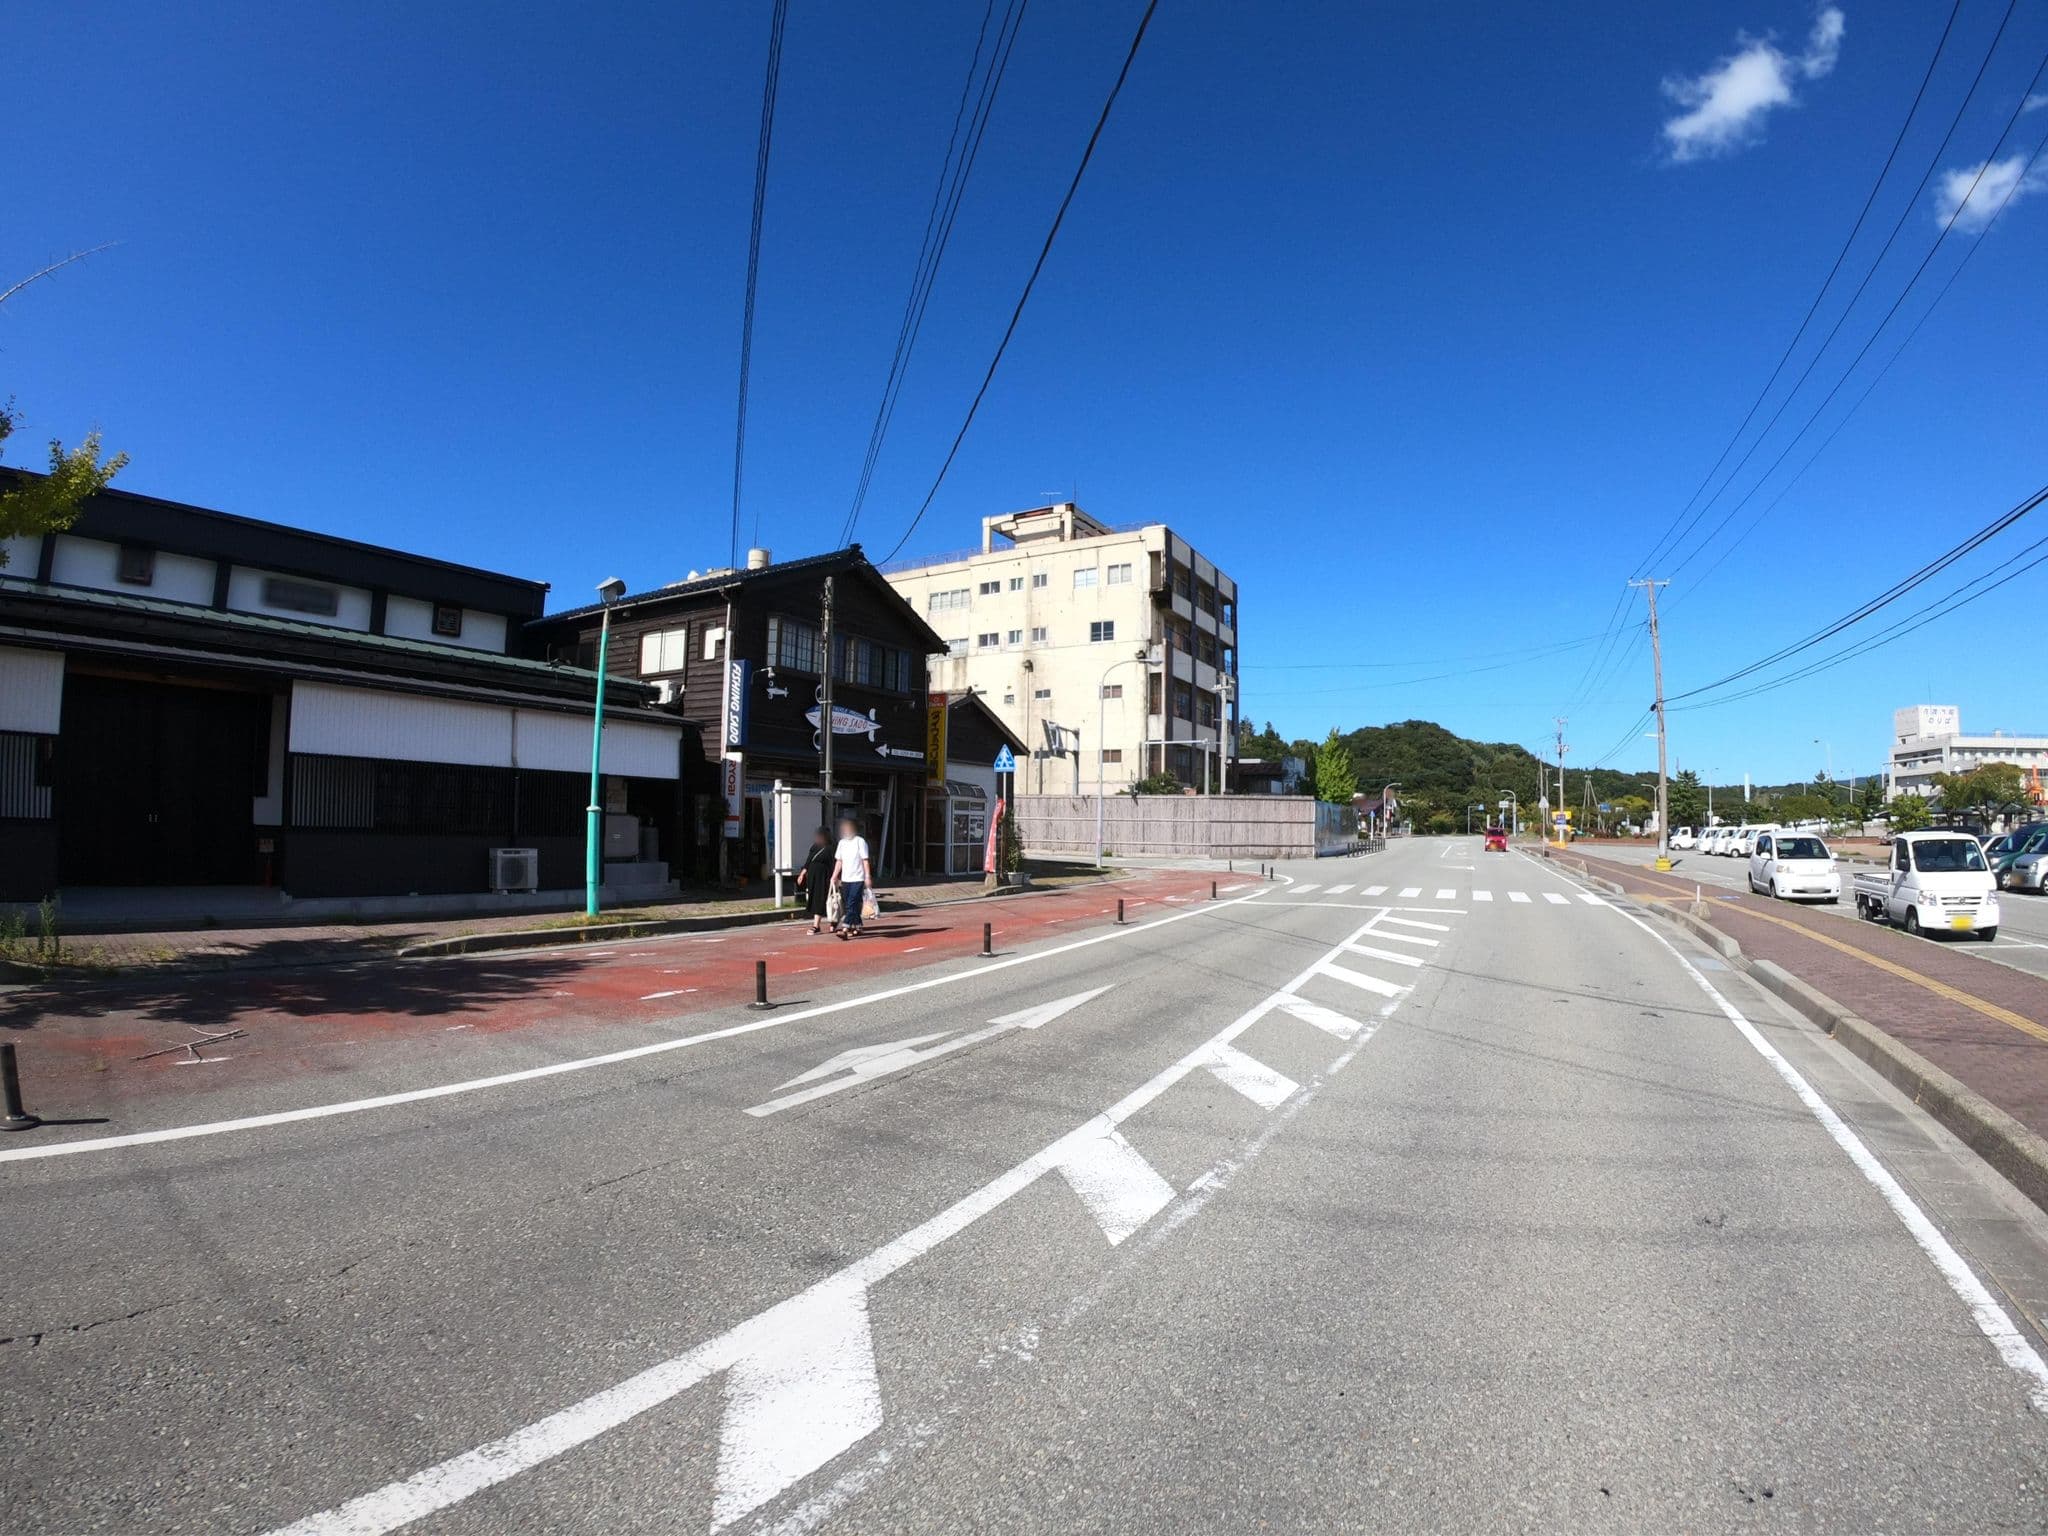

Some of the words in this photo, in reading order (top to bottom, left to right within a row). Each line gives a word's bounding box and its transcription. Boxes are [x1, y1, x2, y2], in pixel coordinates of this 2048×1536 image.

[730, 663, 742, 712] FISHING
[729, 712, 740, 744] SADO
[727, 760, 737, 796] RYOBI
